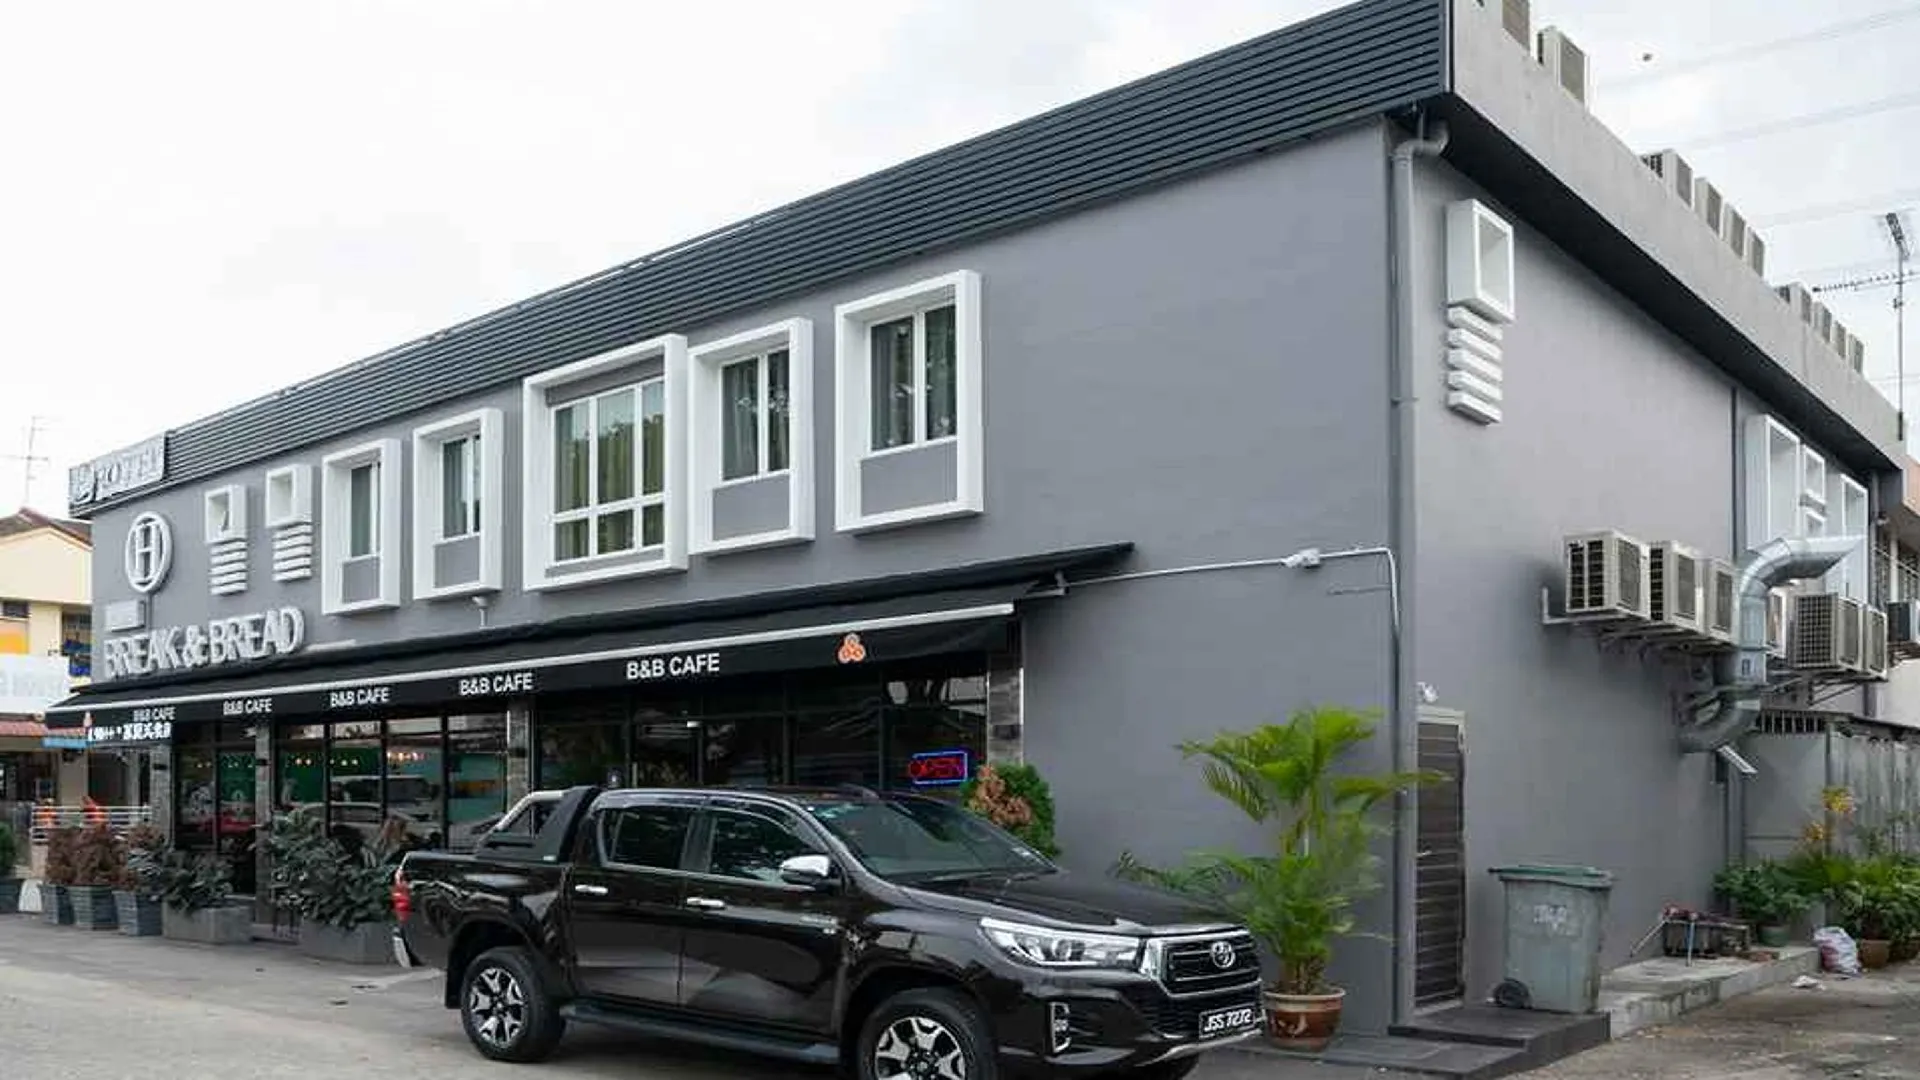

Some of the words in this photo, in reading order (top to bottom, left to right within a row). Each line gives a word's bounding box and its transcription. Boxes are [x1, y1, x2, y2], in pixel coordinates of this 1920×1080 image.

[104, 626, 181, 679] BREAK
[183, 625, 208, 667] &
[208, 606, 305, 664] BREAD
[627, 660, 665, 679] B&B
[669, 653, 720, 676] CAFE
[460, 678, 490, 695] B&B
[493, 672, 533, 692] CAFE
[245, 698, 273, 714] CAFE
[329, 691, 354, 707] B&B
[357, 686, 390, 703] CAFE
[1204, 1013, 1225, 1032] JSS
